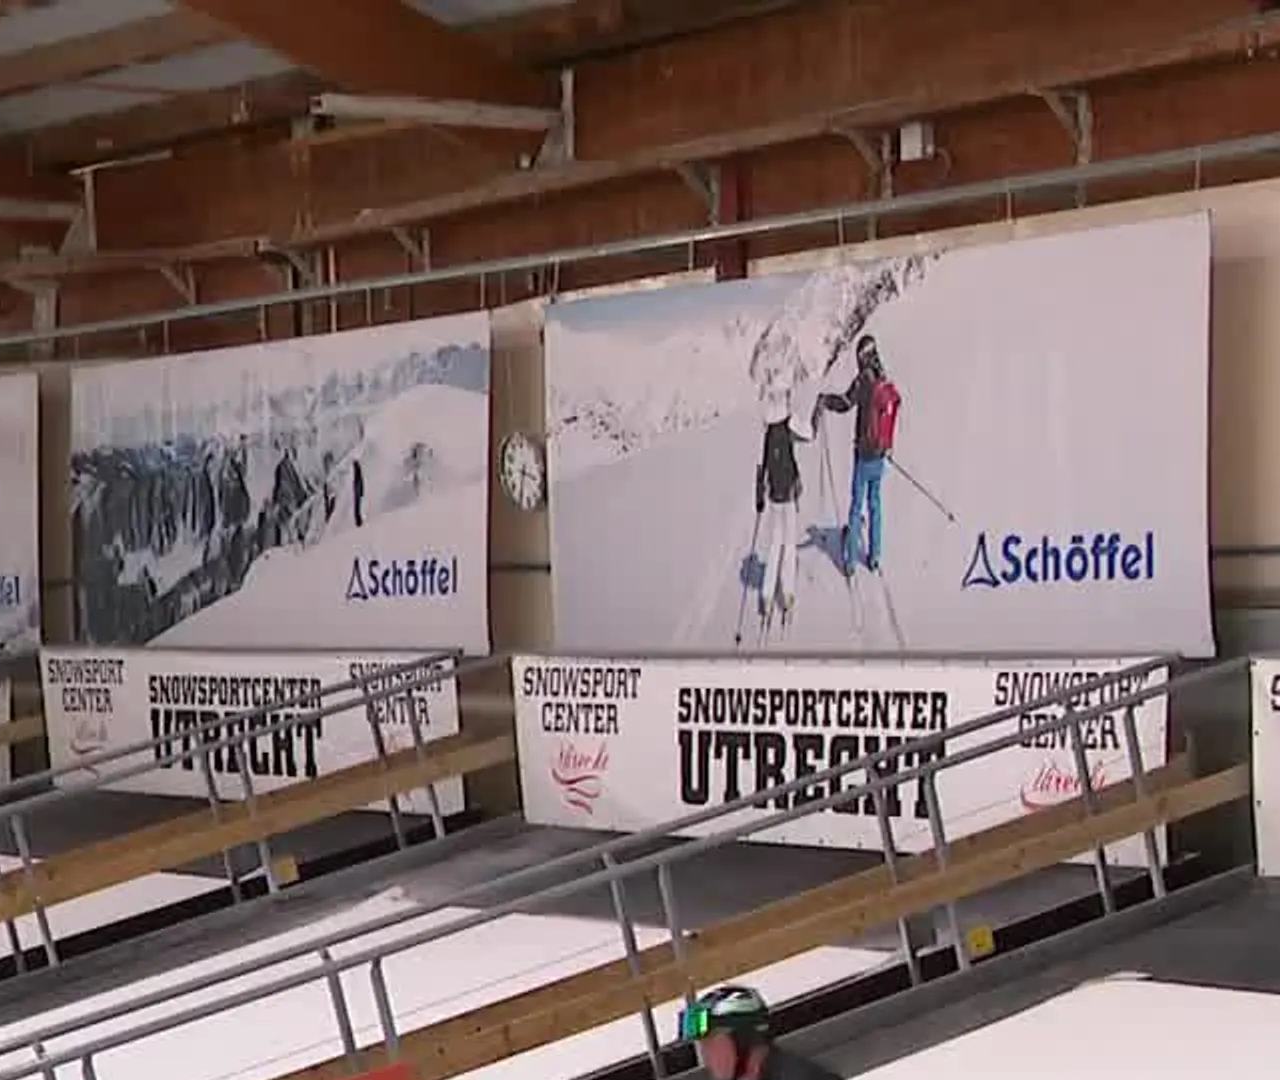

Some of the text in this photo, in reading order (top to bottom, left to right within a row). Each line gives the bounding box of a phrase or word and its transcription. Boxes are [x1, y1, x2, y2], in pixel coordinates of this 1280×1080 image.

[1001, 531, 1154, 584] Schöffel
[368, 556, 458, 597] Schöffel
[62, 687, 114, 713] CENTER
[149, 675, 322, 709] SNOWSPORTCENTER
[523, 666, 642, 699] SNOWSPORT
[541, 702, 619, 734] CENTER
[677, 687, 948, 730] SNOWSPORTCENTER
[677, 729, 947, 819] UTRECHT
